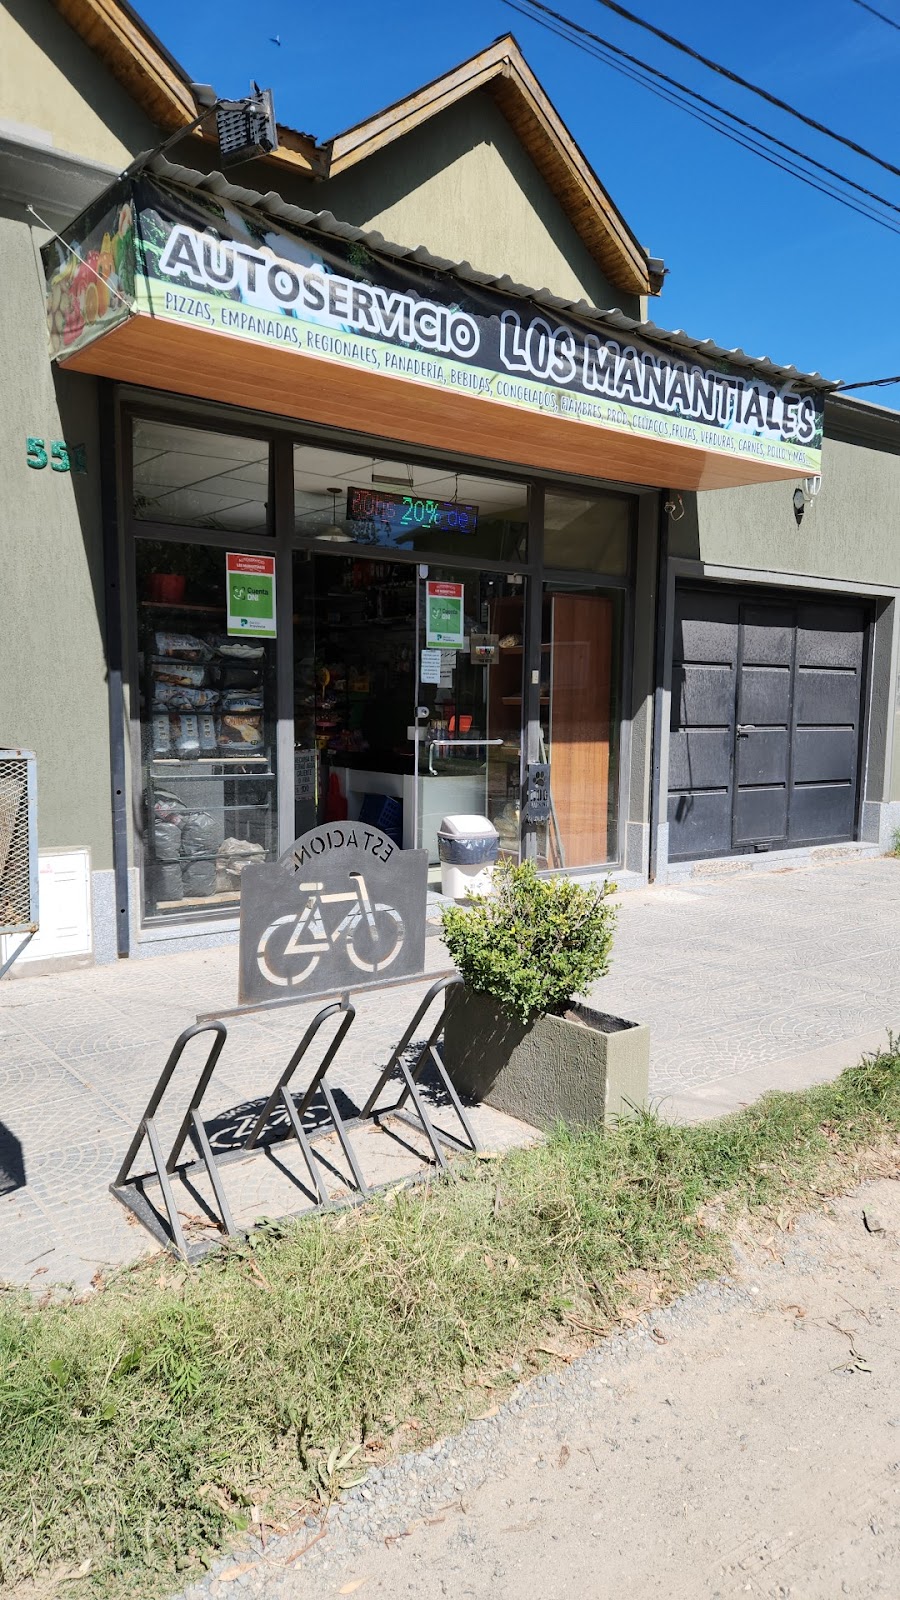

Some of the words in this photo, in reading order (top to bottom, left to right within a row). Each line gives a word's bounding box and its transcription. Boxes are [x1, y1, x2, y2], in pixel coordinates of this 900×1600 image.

[159, 224, 480, 357] AUTOSERVICIO
[500, 310, 576, 384] LOS
[582, 334, 817, 443] MANANTIALES
[165, 291, 215, 326] PIZZAS,
[221, 307, 302, 348] EMPANADAS,
[307, 331, 380, 369] REGIONALES,
[385, 351, 447, 384] PANADERÍA,
[450, 369, 493, 397] BEBIDAS,
[497, 380, 558, 414] CONGELADOS,
[700, 431, 736, 451] VERDURAS,
[738, 439, 765, 457] CARNES,
[401, 497, 440, 526] 20%
[247, 587, 269, 596] Cuenta
[247, 594, 260, 602] DNI
